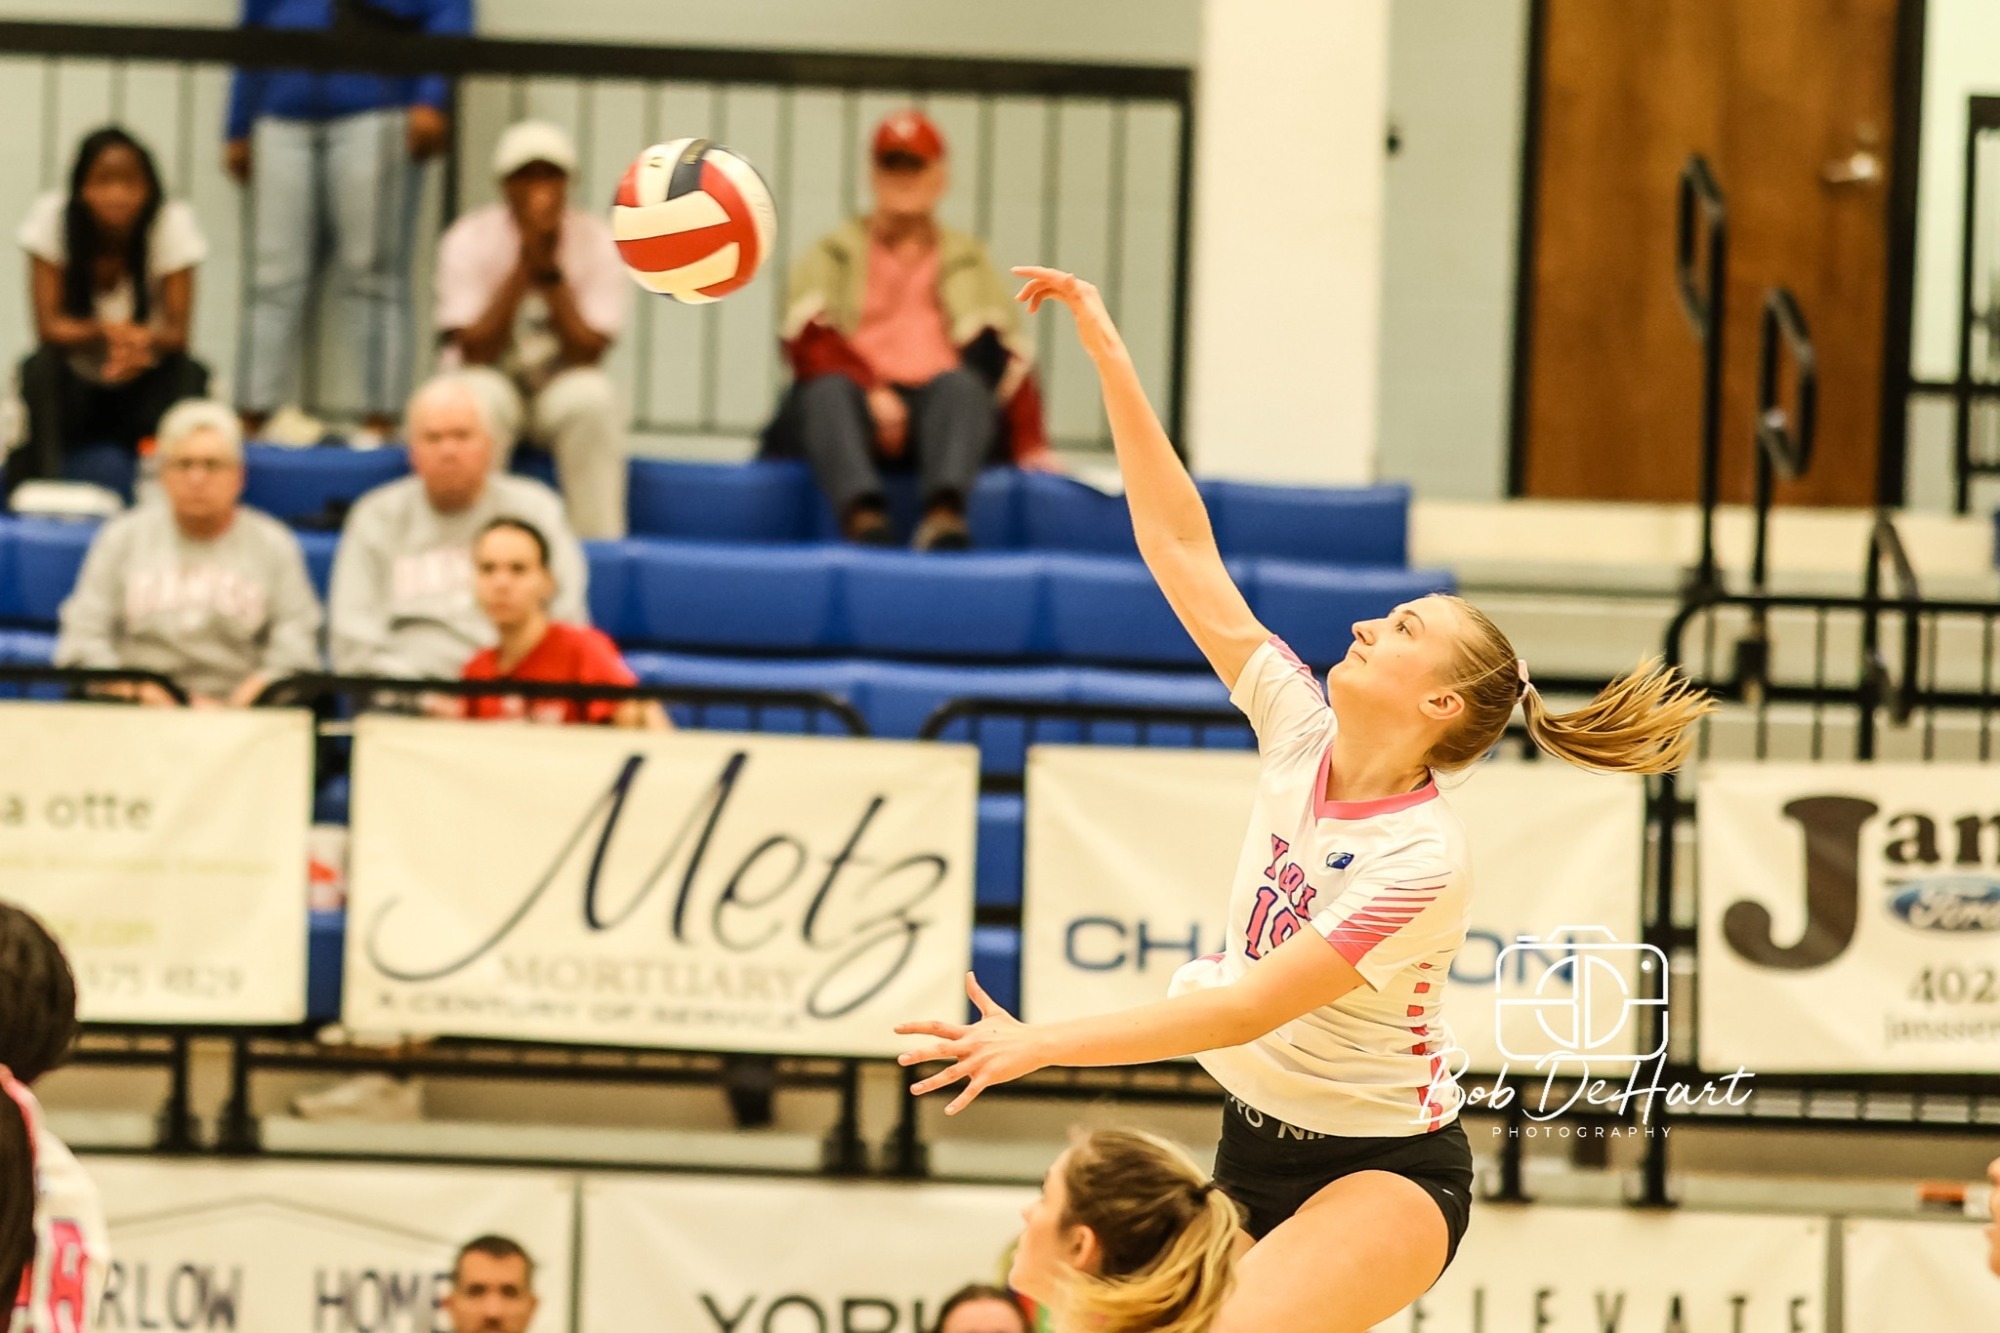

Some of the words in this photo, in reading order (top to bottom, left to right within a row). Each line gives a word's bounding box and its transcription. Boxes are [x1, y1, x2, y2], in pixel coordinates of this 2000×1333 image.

[44, 789, 155, 832] otte
[365, 749, 948, 1020] Metz
[500, 951, 806, 1003] MORTUARY
